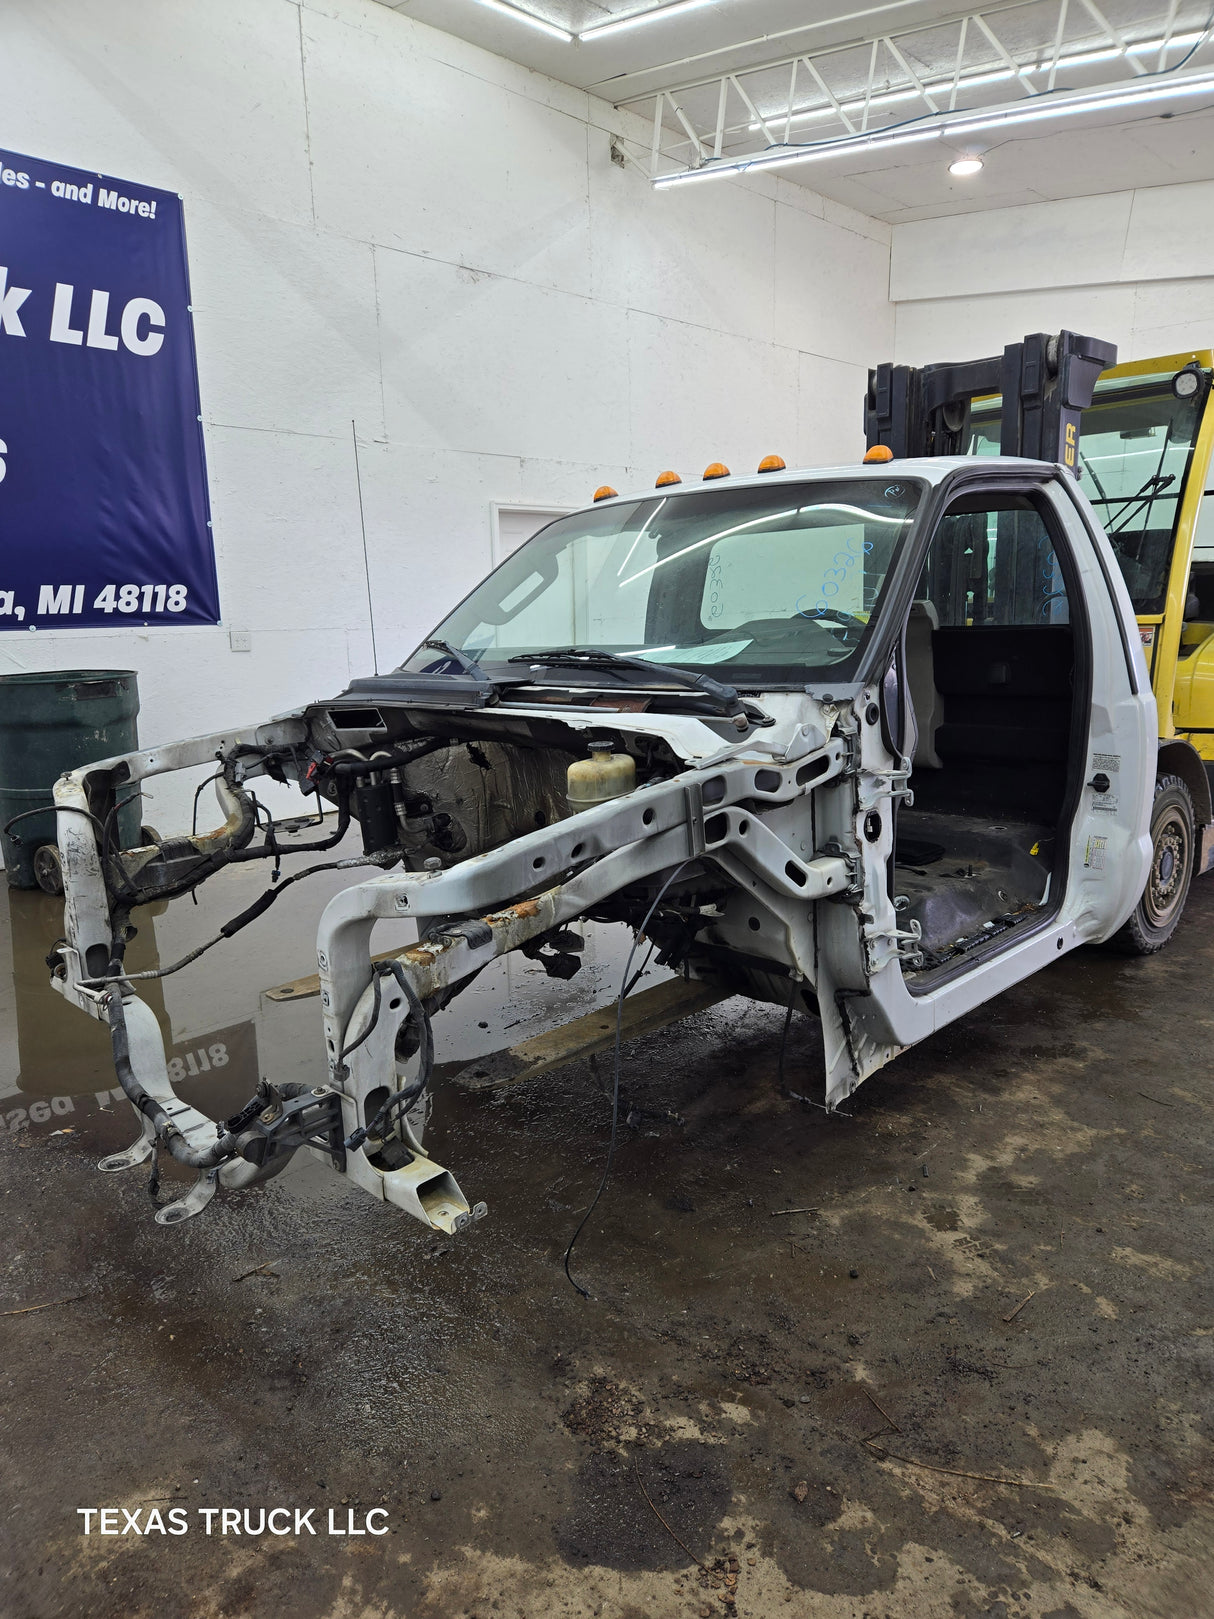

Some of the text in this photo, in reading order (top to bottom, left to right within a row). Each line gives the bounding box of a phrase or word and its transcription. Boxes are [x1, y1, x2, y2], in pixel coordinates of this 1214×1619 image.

[51, 180, 94, 204] and
[97, 188, 157, 219] More!
[49, 282, 166, 357] LLC
[37, 584, 85, 615] MI
[93, 584, 188, 613] 48118
